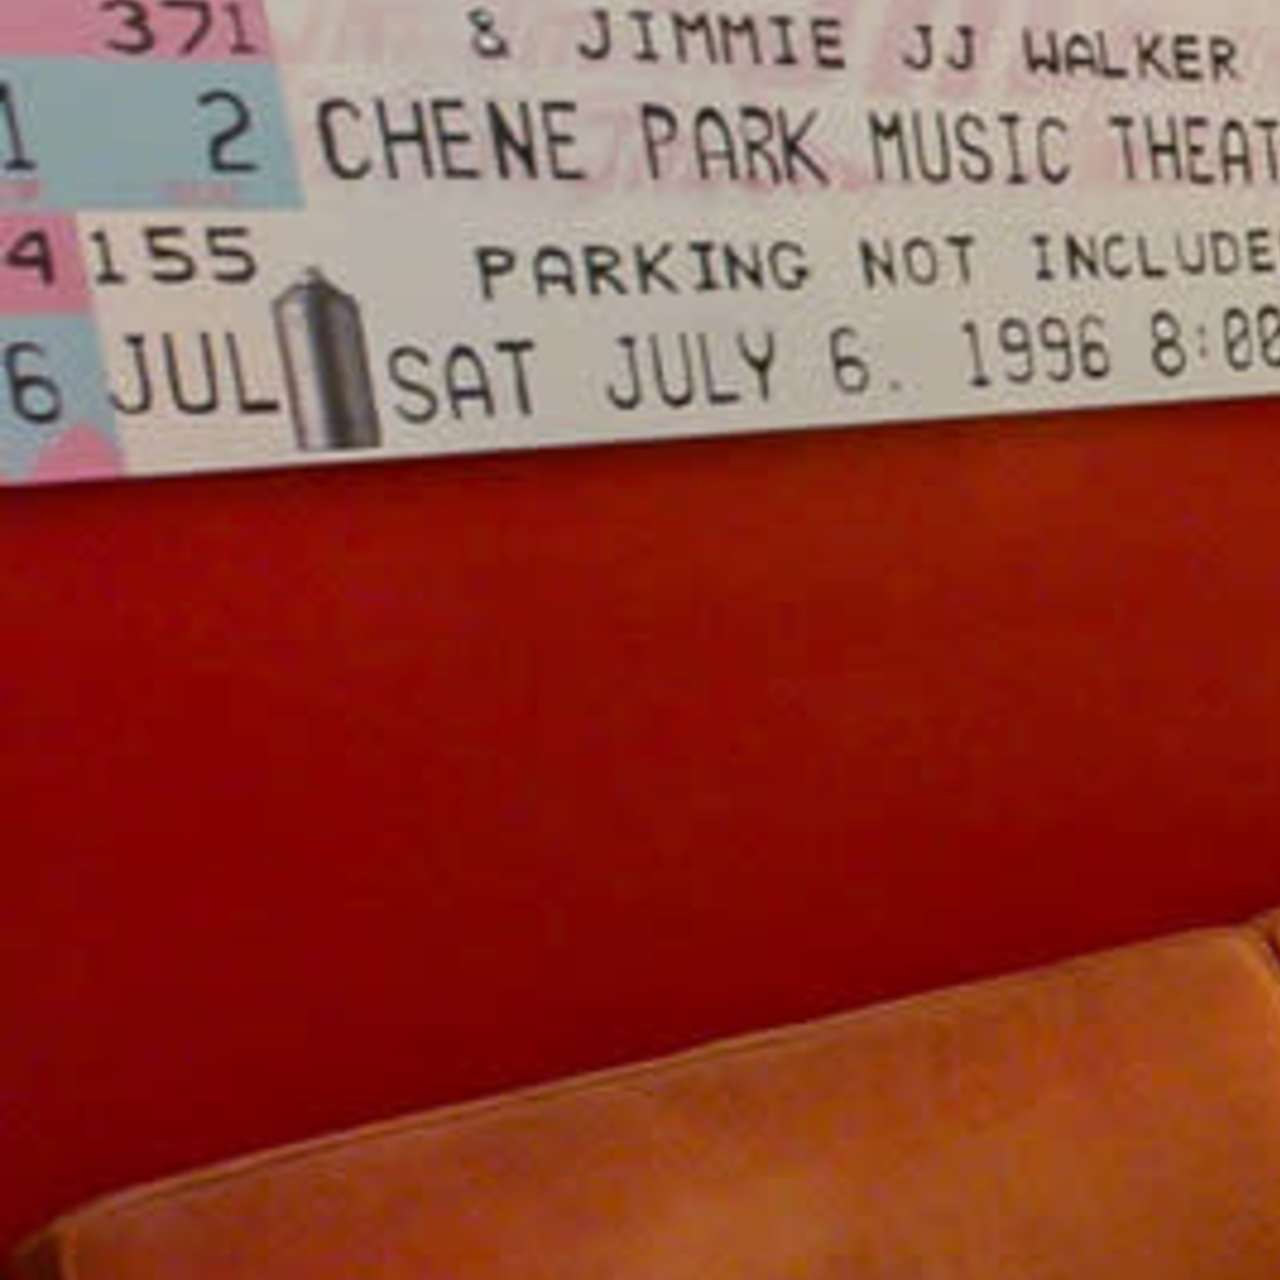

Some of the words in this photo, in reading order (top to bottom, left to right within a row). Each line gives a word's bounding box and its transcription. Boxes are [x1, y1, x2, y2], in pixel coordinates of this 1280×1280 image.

[578, 8, 848, 72] JIMMIE
[902, 24, 978, 74] JJ
[1022, 28, 1244, 84] WALKER
[196, 88, 262, 174] 2
[316, 98, 588, 182] CHENE
[640, 104, 830, 186] PARK
[870, 114, 1072, 184] MUSIC
[476, 240, 810, 300] PARKING
[860, 236, 976, 290] NOT
[6, 338, 62, 424] 6
[108, 332, 282, 416] JUL
[388, 340, 538, 424] SAT
[606, 334, 776, 412] JULY
[964, 316, 1110, 388] 1996
